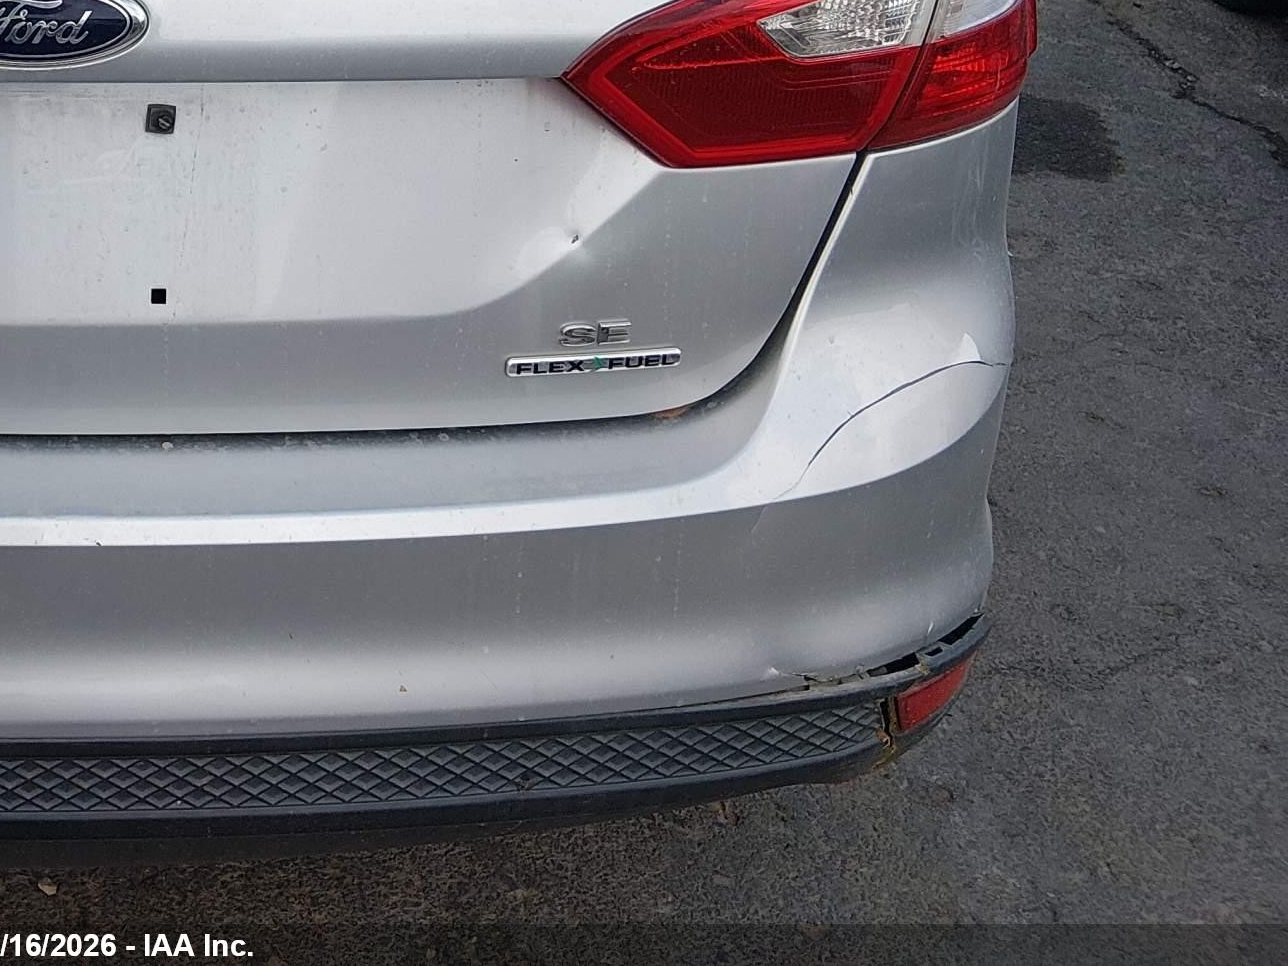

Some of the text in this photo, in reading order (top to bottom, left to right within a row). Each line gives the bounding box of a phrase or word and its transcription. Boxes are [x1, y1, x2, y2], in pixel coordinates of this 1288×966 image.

[559, 319, 632, 347] SE
[515, 353, 682, 376] FLEX FUEL
